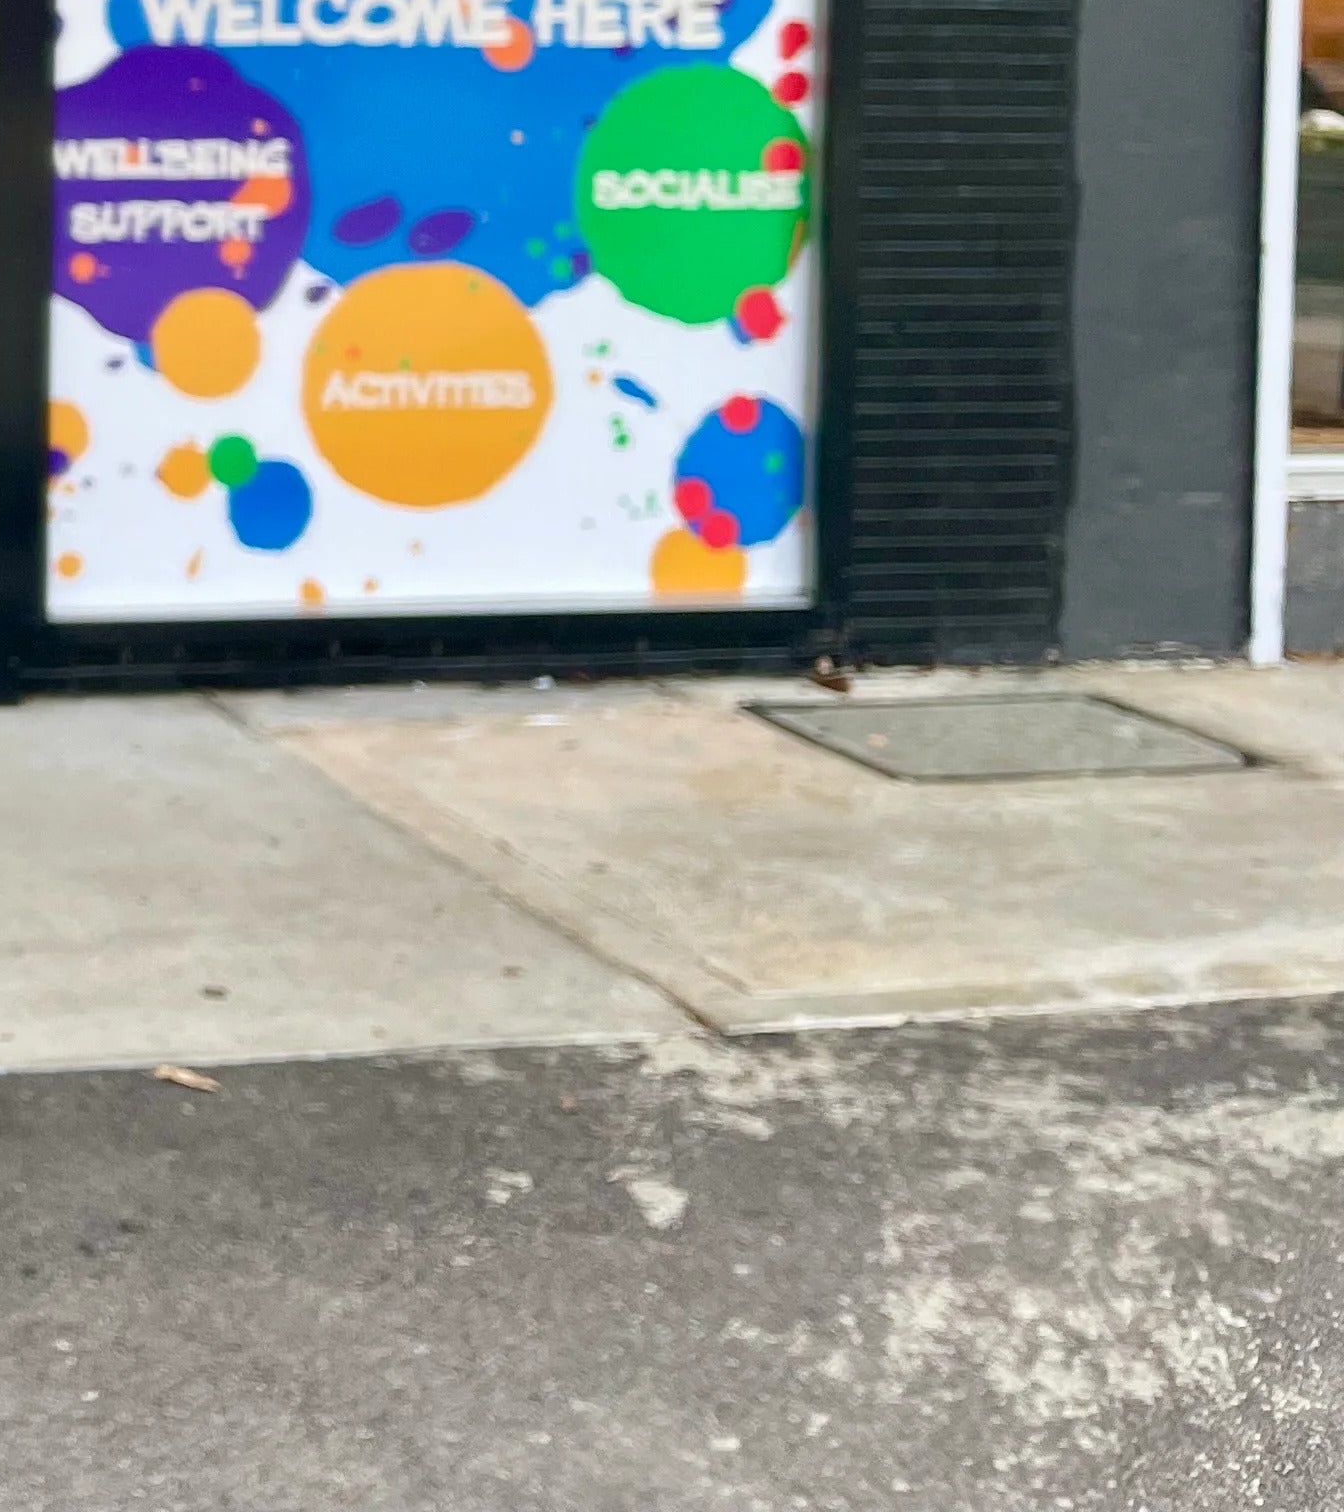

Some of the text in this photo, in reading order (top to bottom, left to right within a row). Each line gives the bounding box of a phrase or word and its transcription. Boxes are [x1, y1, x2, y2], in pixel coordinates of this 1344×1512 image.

[53, 137, 291, 180] WELLBEING
[592, 169, 803, 210] SOCIALISE
[69, 199, 269, 243] SUPPORT
[321, 370, 536, 410] ACTIVITIES
